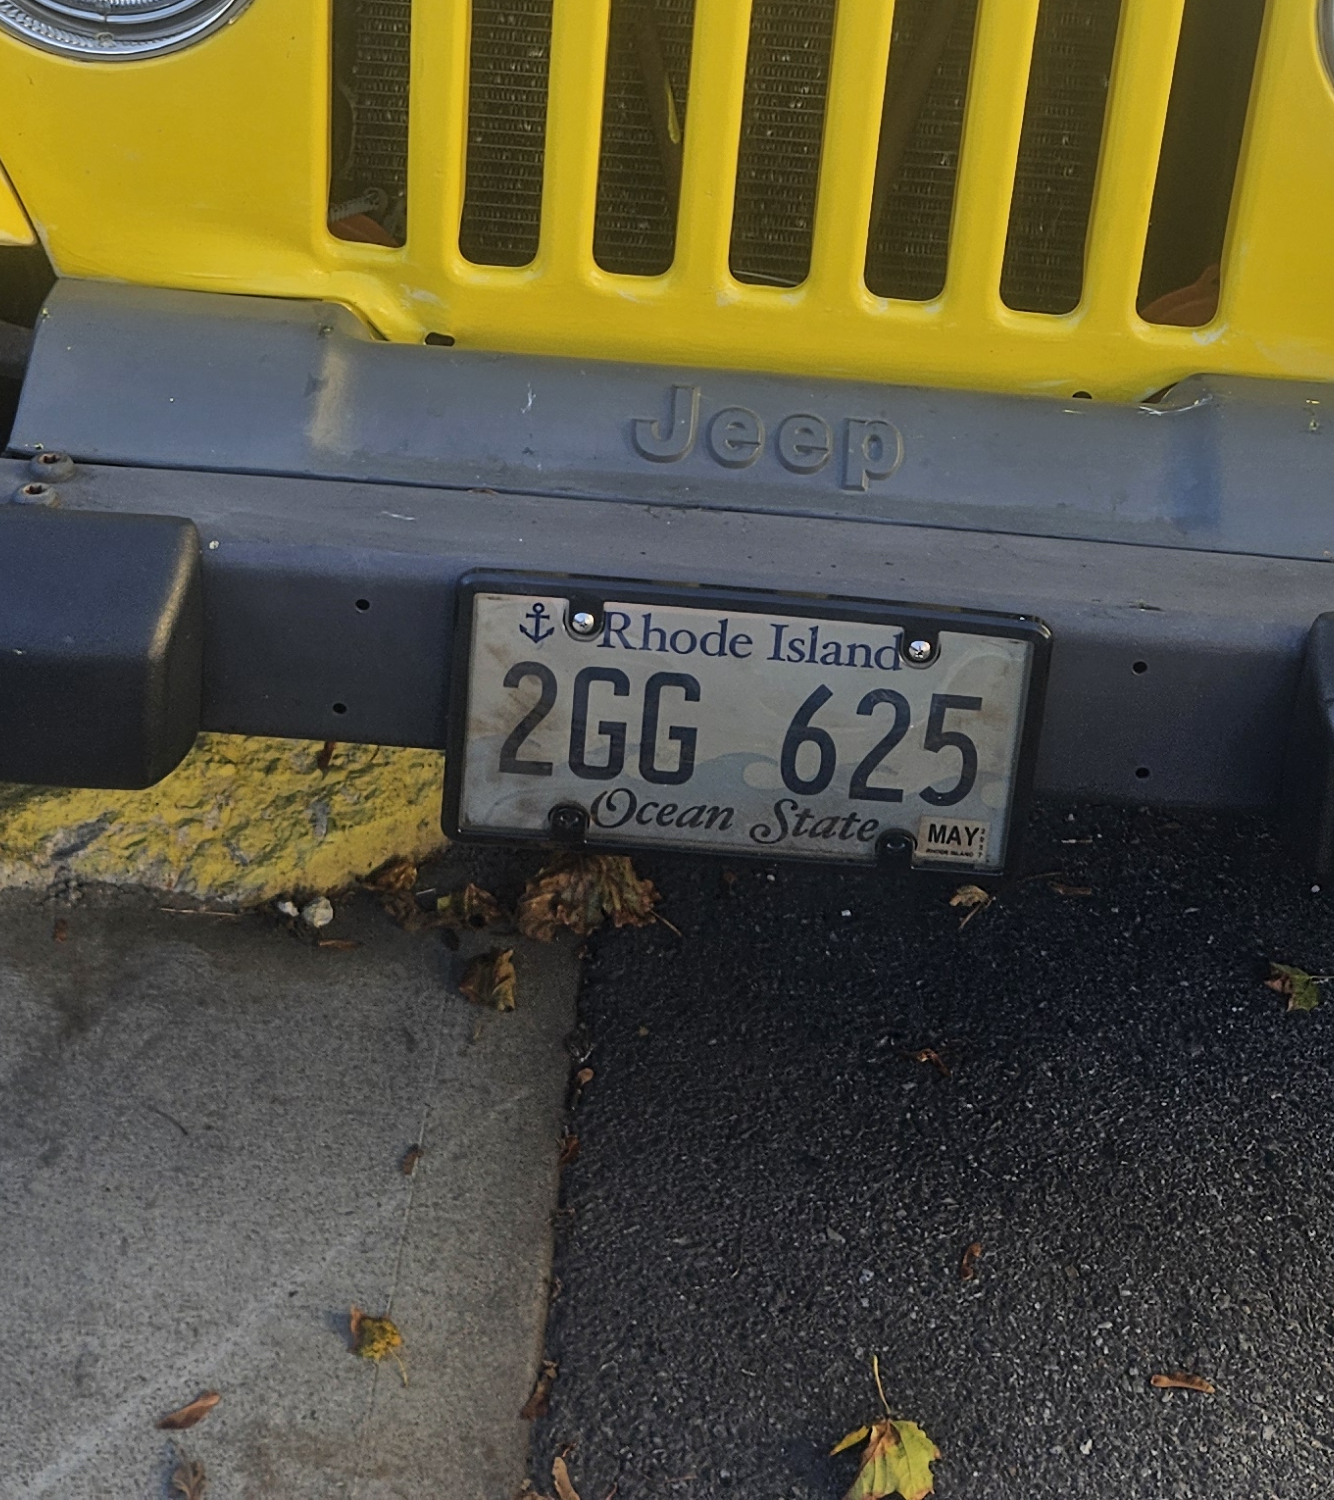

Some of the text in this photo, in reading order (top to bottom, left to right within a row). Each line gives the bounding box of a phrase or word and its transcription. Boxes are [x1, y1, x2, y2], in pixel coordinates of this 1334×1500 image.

[630, 384, 904, 491] Jeep
[597, 610, 904, 671] Rhode Island
[498, 660, 983, 807] 2GG 625
[590, 788, 880, 845] Ocean State
[928, 823, 979, 846] MAY
